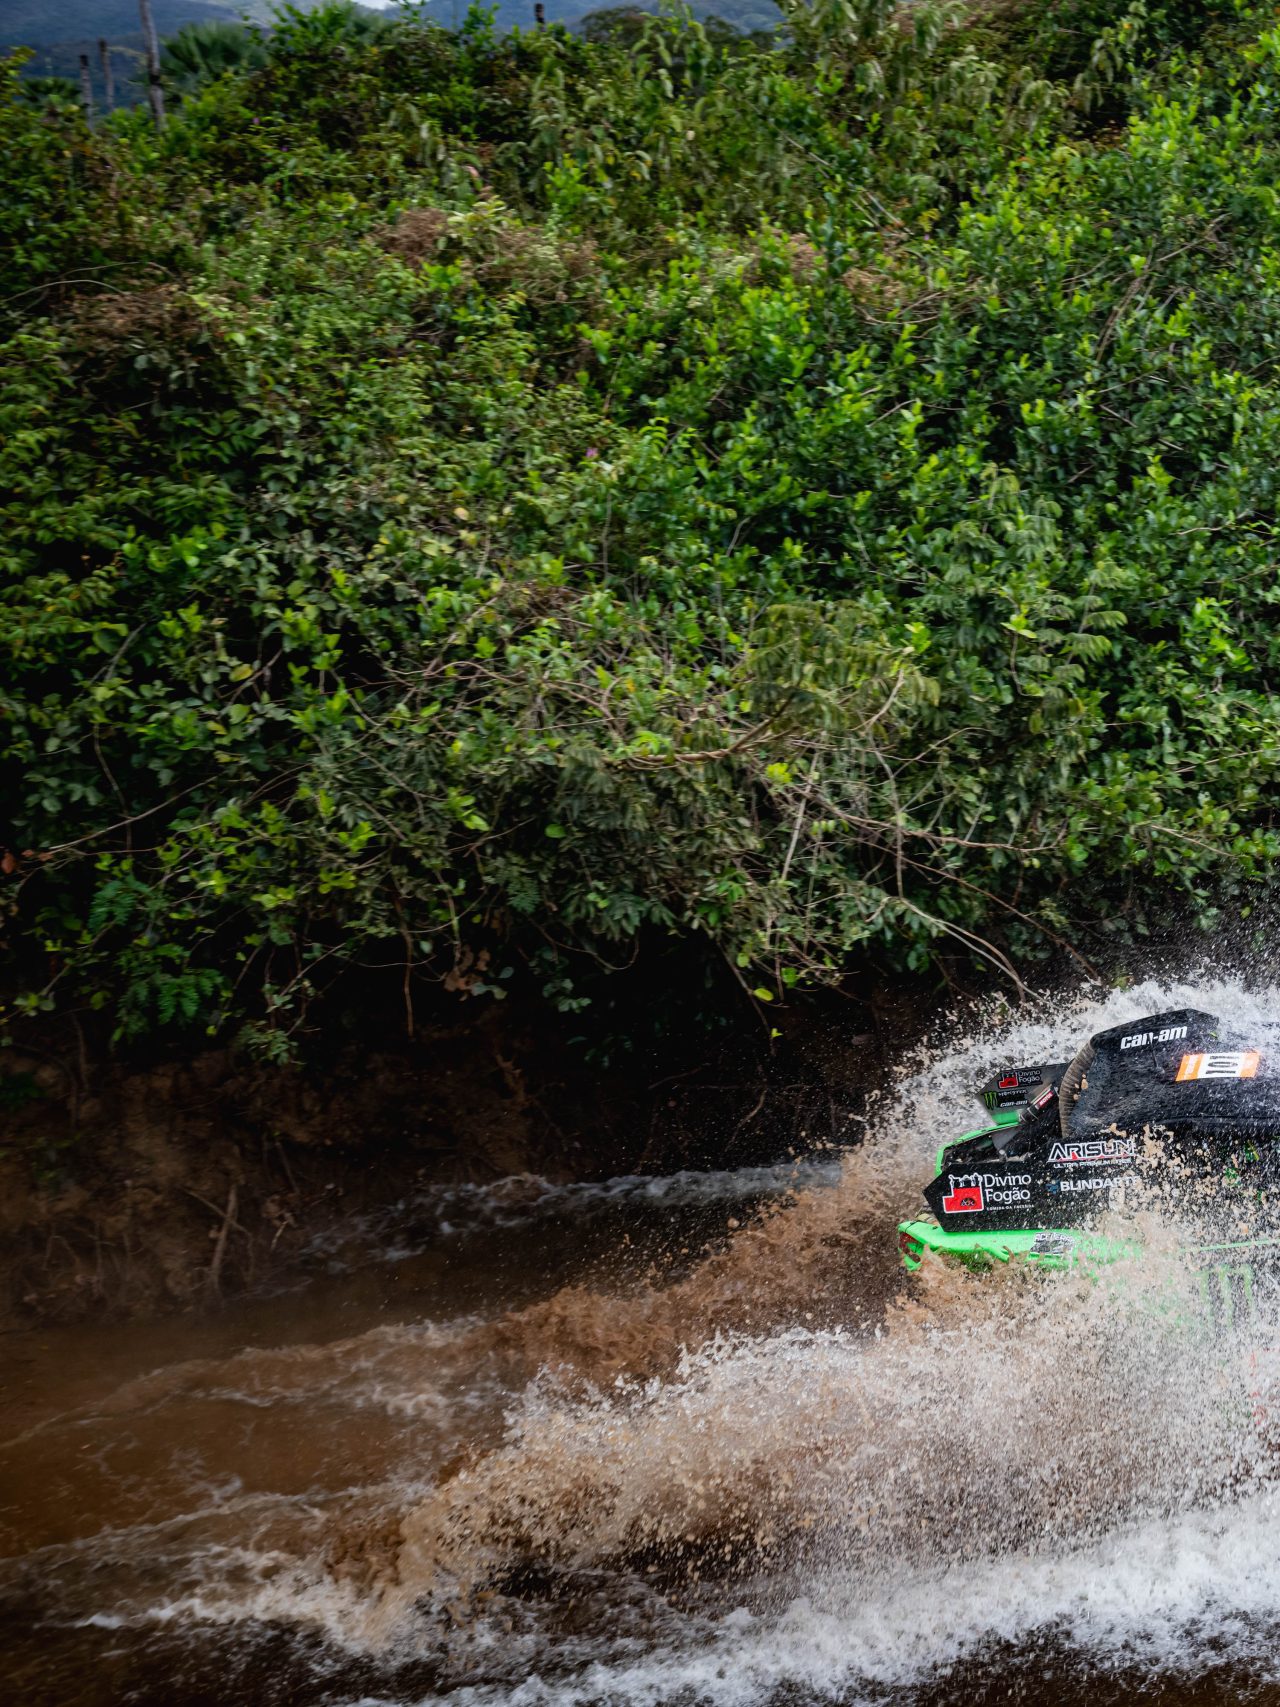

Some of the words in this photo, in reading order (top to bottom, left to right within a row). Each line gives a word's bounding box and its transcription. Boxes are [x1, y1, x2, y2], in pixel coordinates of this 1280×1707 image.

[1120, 1026, 1187, 1049] can-am
[1018, 1075, 1041, 1083] Fogão
[1000, 1100, 1028, 1108] can-am
[1048, 1140, 1135, 1161] ARISUN
[982, 1172, 1032, 1188] Divino
[984, 1187, 1031, 1205] Fogão
